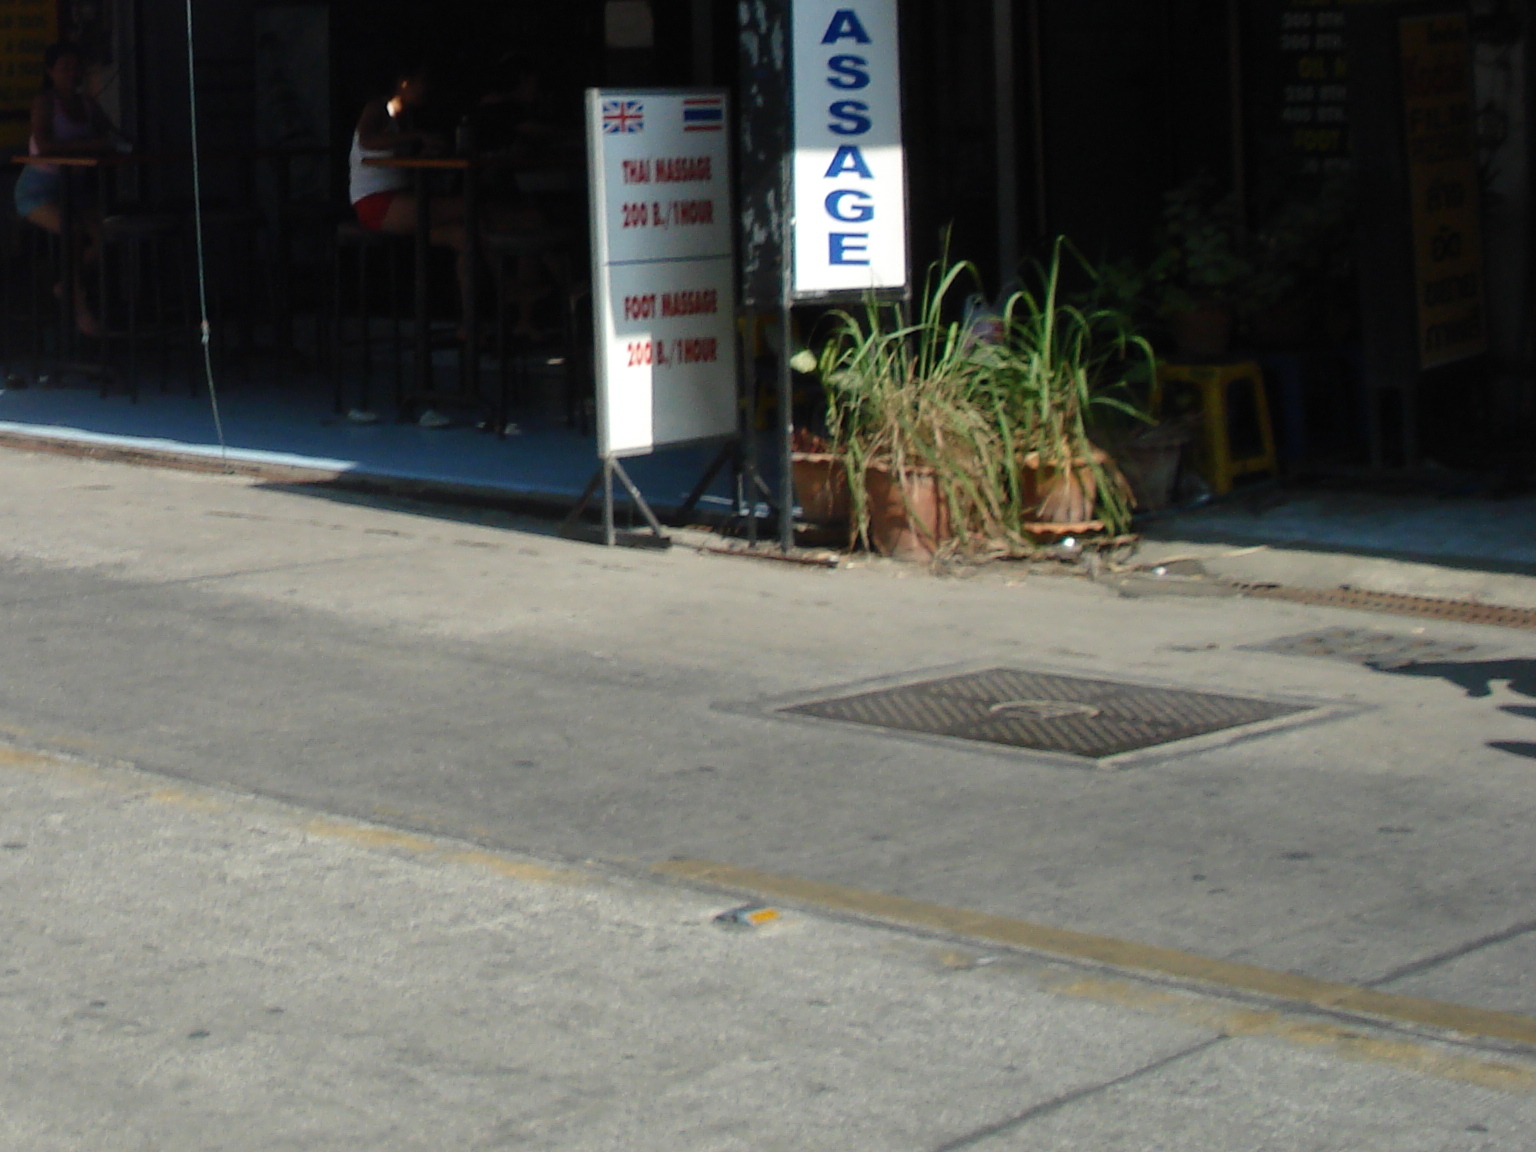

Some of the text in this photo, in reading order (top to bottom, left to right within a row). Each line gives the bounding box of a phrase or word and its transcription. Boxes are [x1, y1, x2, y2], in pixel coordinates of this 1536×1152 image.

[622, 155, 712, 184] THAI MASSAGE
[621, 203, 648, 229] 200
[625, 288, 718, 321] FOOT MASSAGE
[627, 341, 652, 368] 200
